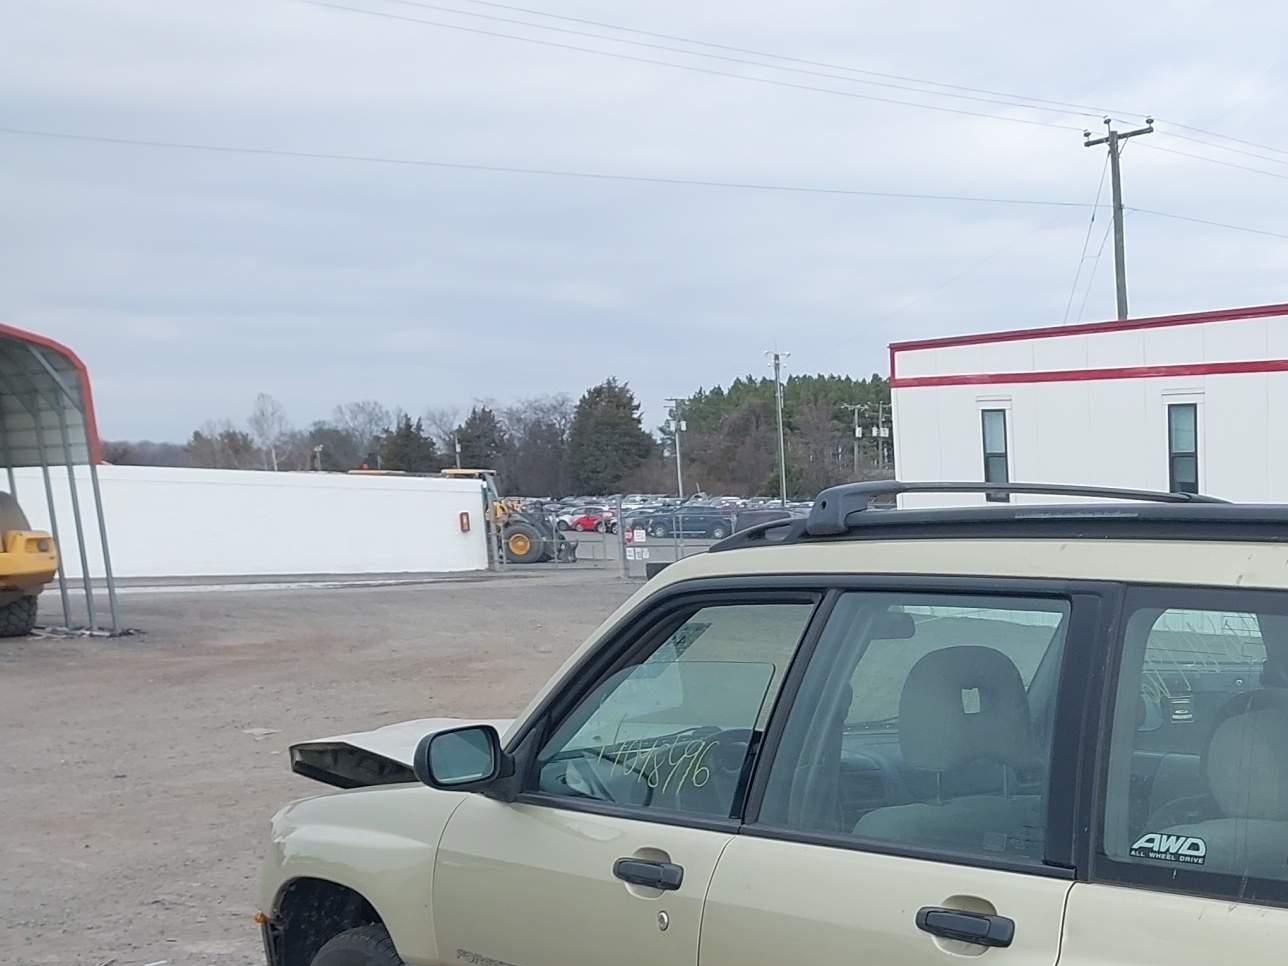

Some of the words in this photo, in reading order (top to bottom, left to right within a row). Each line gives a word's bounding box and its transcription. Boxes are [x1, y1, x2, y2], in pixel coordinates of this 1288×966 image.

[1131, 833, 1206, 857] AWD
[1149, 852, 1176, 860] WHEEL
[1179, 855, 1204, 864] DRIVE
